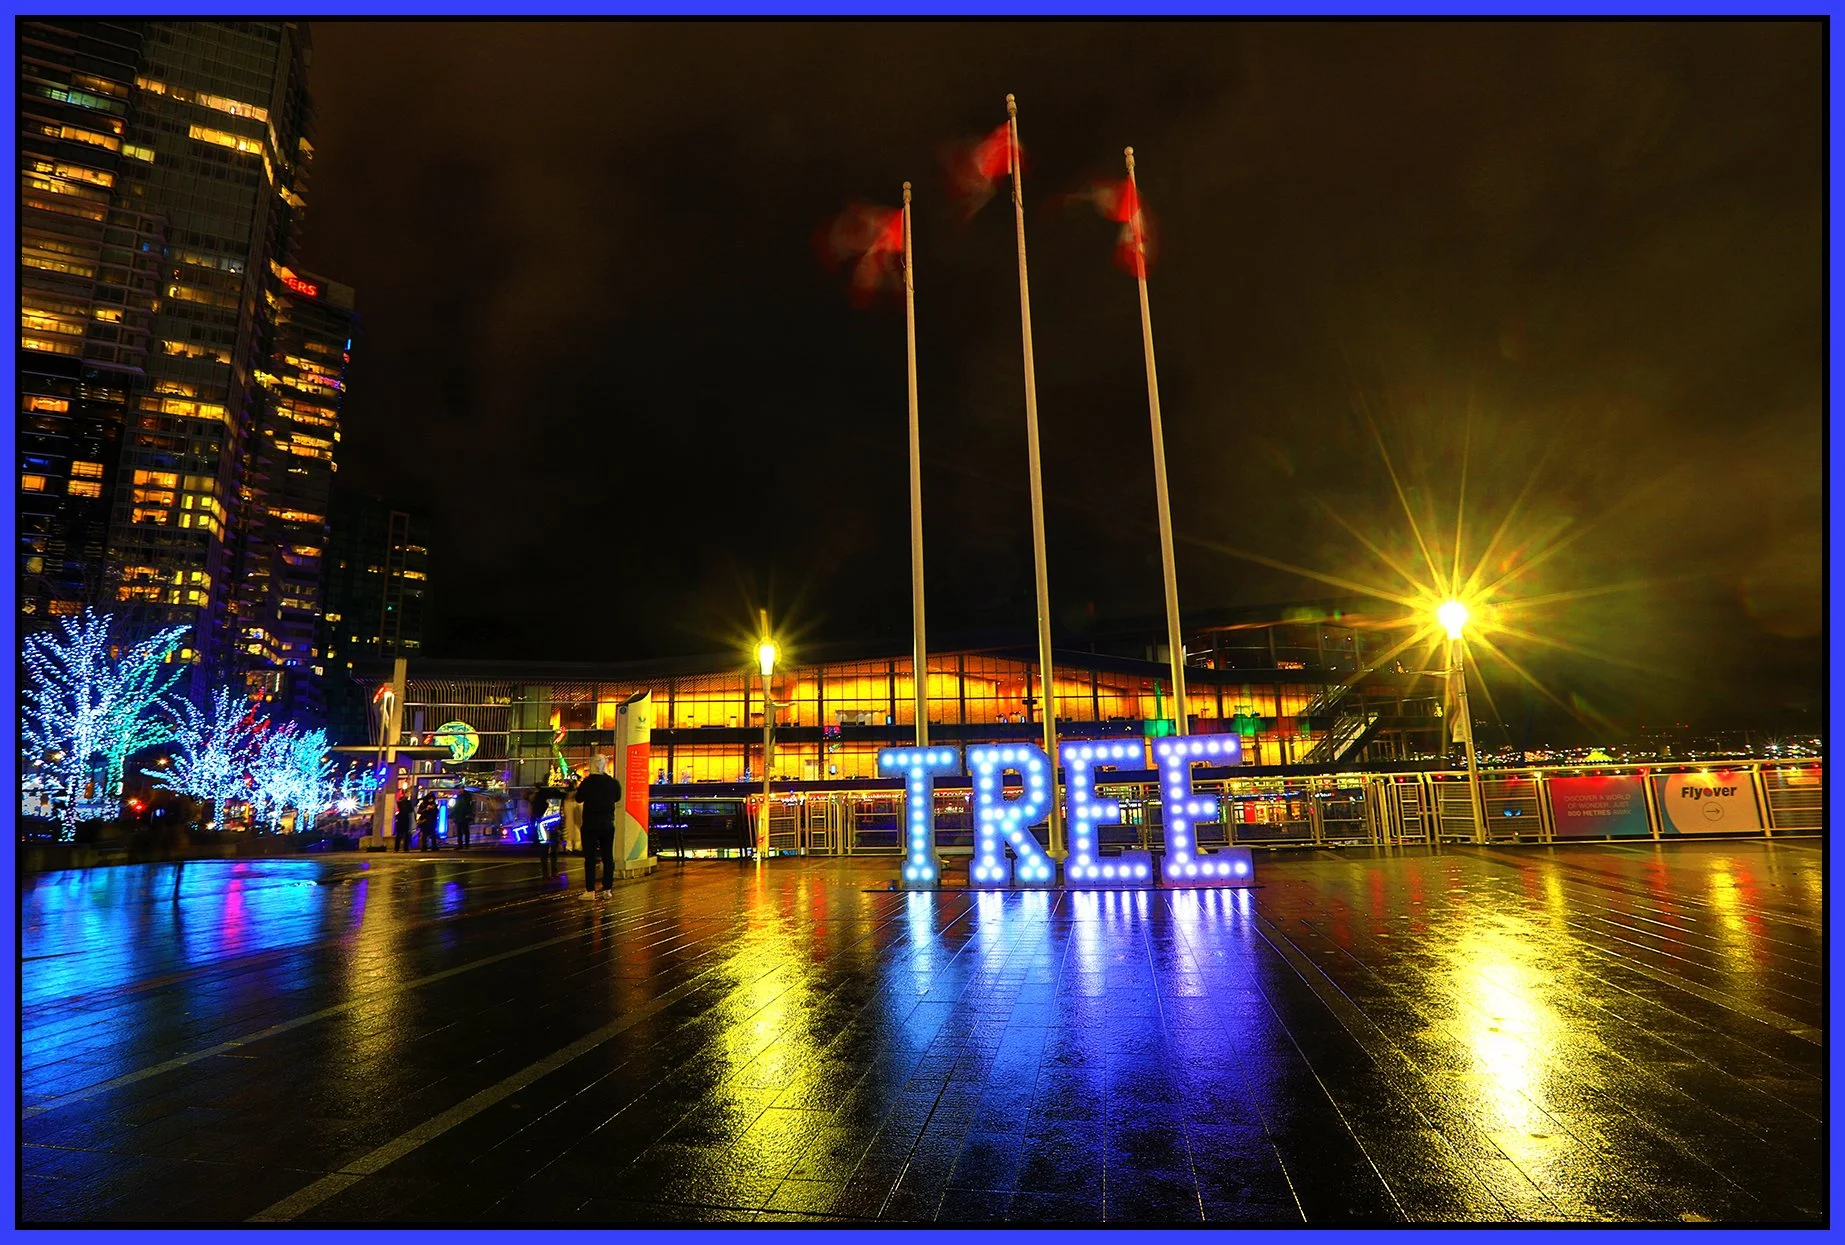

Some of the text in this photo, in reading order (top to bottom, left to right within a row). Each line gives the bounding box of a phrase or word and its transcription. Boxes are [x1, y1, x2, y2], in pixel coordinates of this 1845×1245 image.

[286, 278, 318, 296] ERS
[1681, 786, 1737, 800] Flyover
[877, 732, 1256, 888] TREE
[1583, 809, 1612, 817] METRES
